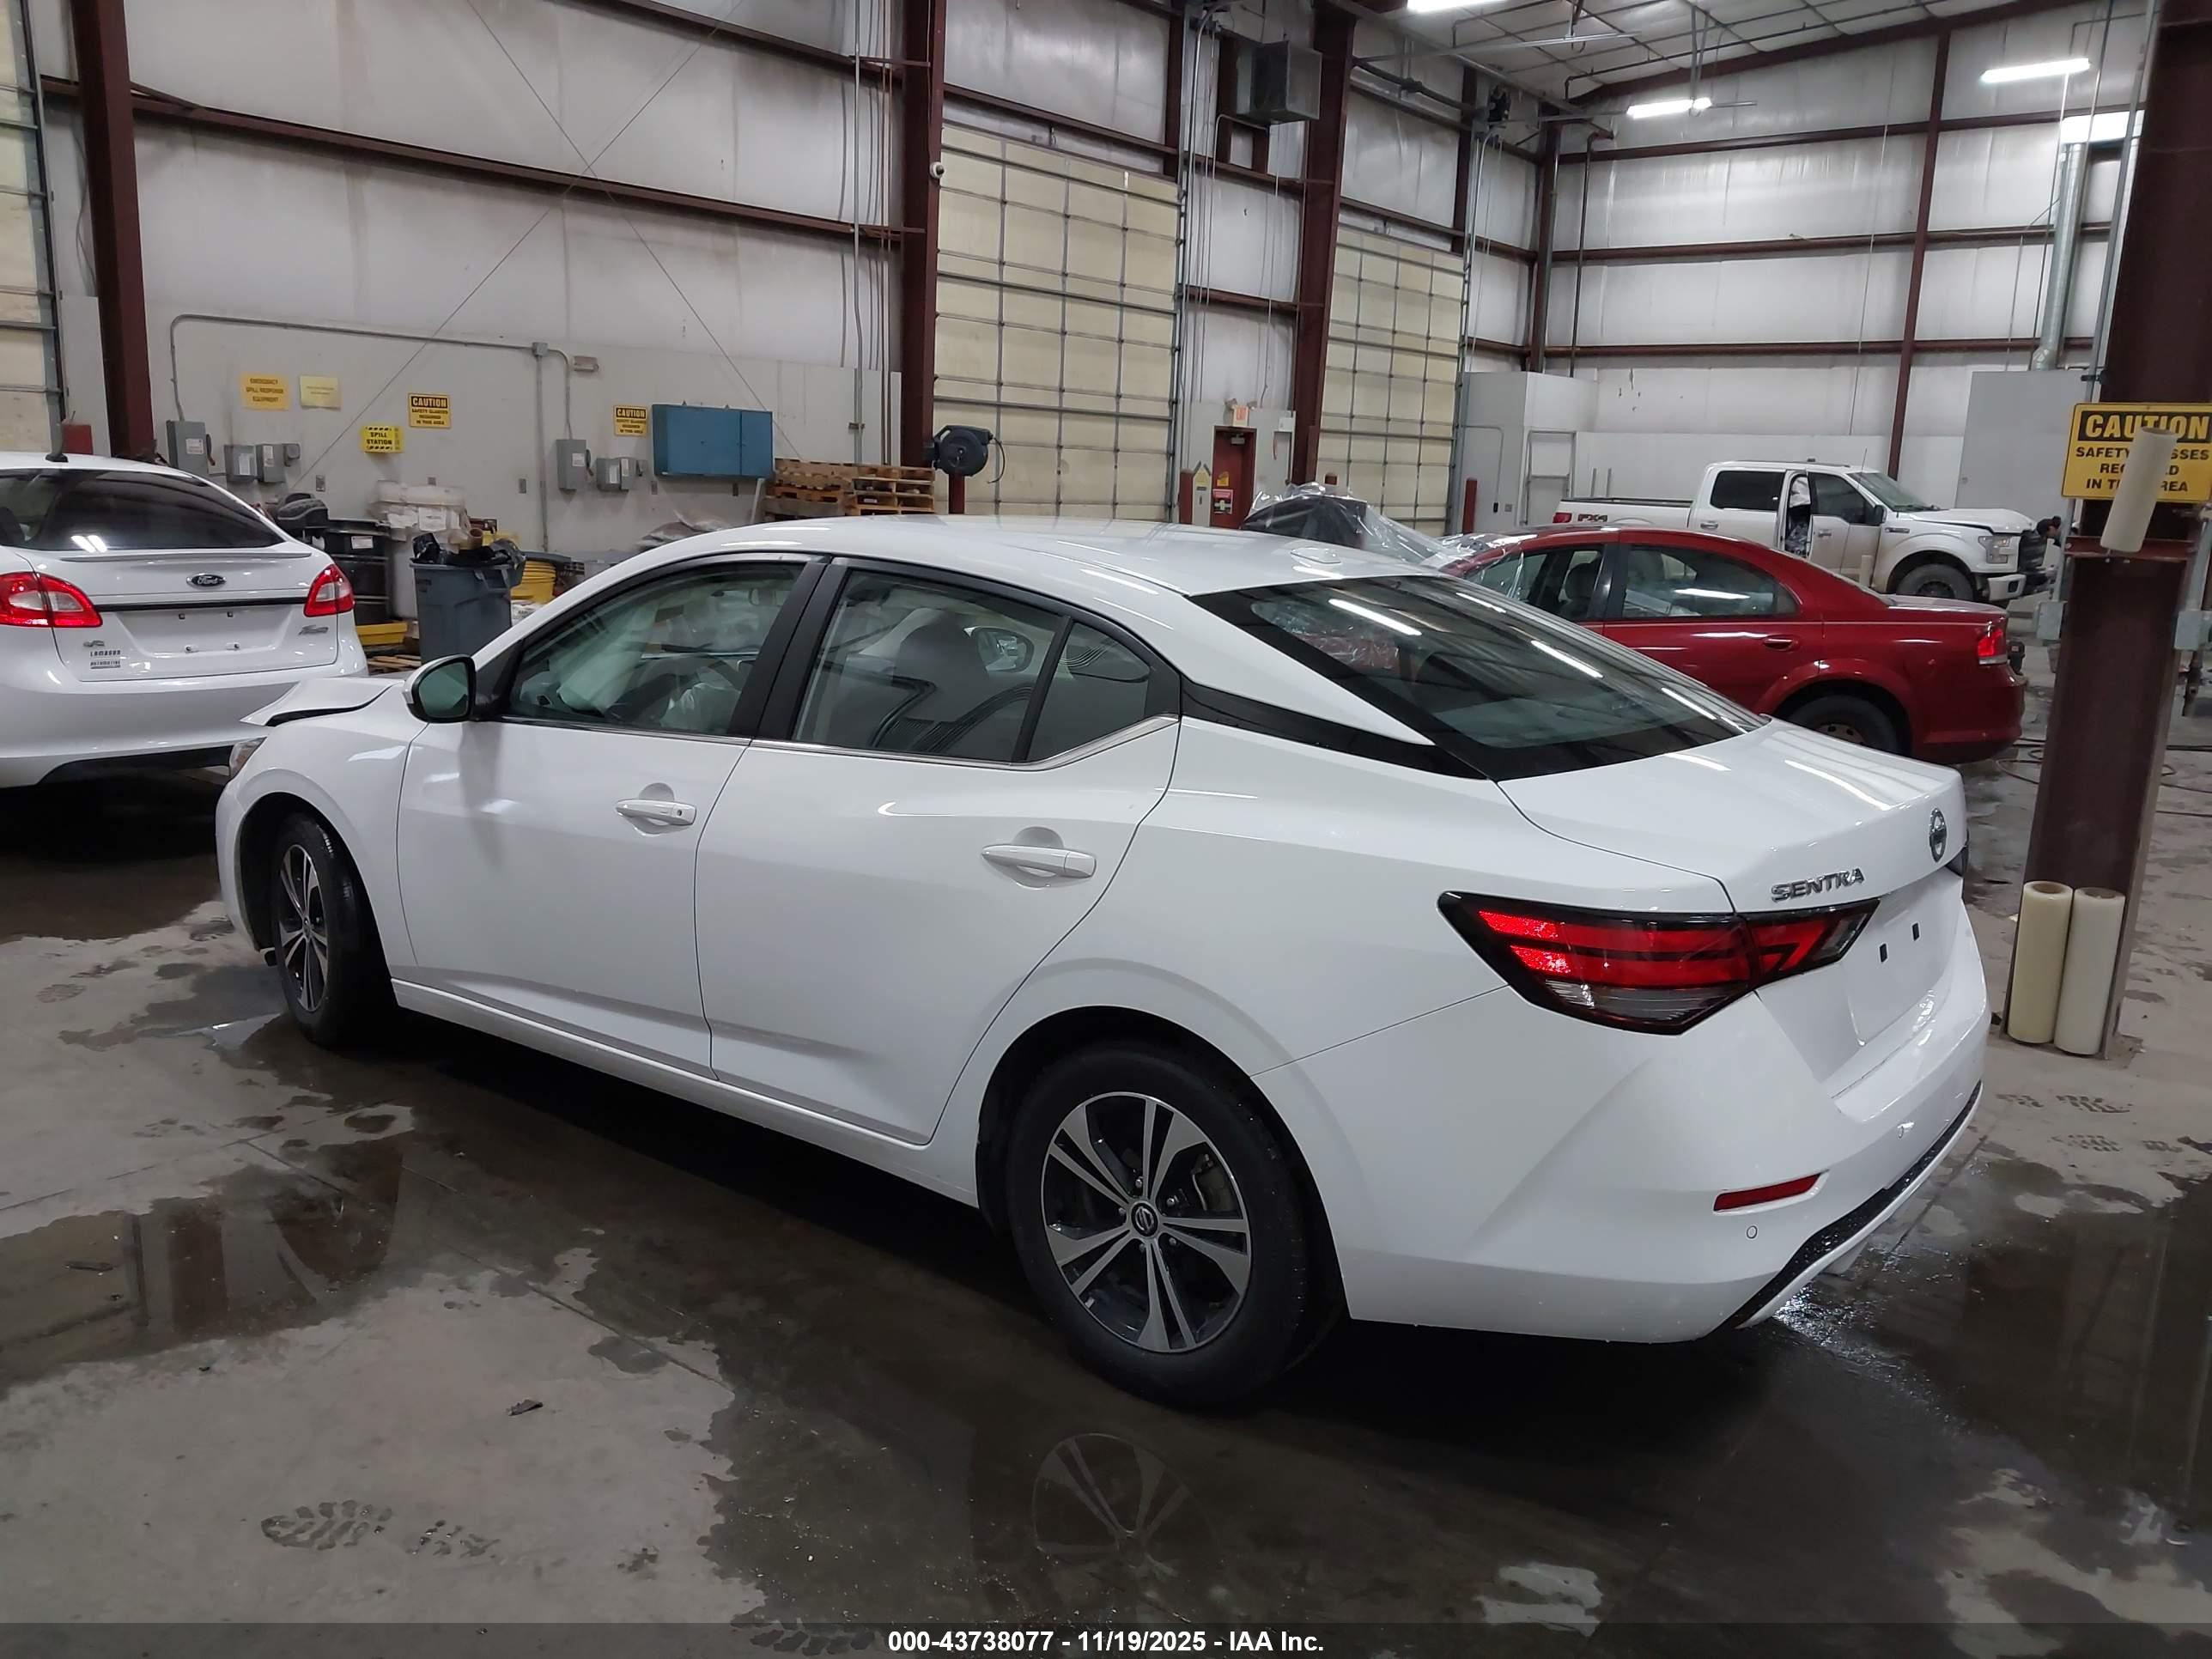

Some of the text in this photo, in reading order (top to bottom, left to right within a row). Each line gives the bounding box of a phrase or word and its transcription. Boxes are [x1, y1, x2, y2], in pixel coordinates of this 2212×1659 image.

[412, 397, 447, 408] CAUTION
[617, 409, 645, 417] CAUTION
[2075, 447, 2130, 459] SAFETY
[2086, 478, 2102, 489] IN
[1577, 514, 1608, 523] FX4
[1771, 867, 1865, 903] SENTRA
